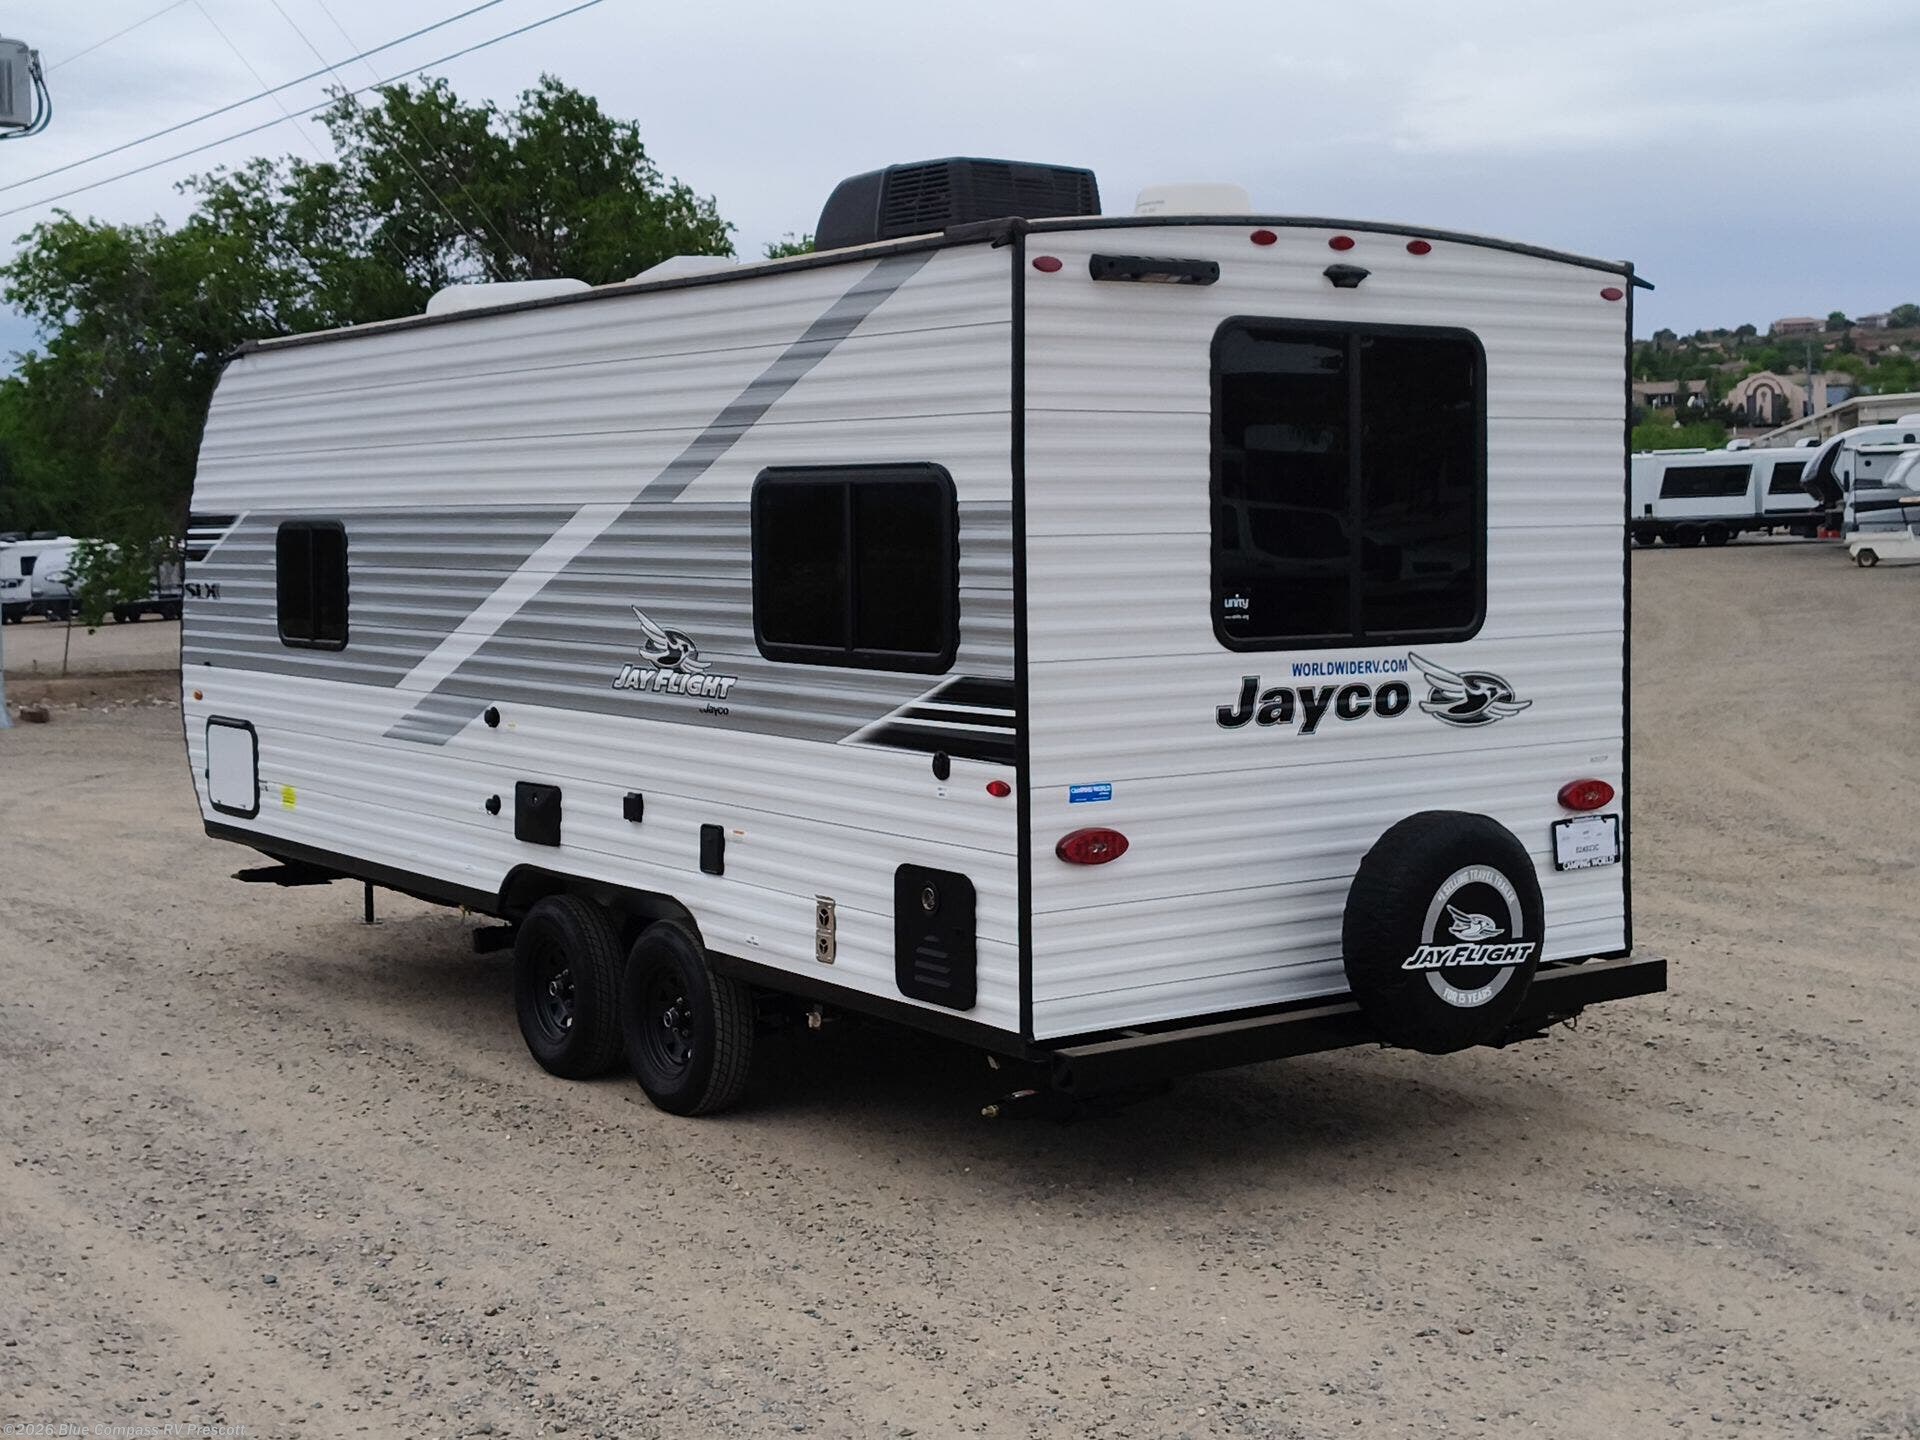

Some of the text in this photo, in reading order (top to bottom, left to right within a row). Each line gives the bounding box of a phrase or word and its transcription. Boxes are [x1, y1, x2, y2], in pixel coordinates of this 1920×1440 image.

[1291, 658, 1408, 677] WORLDWIDERV.COM
[612, 663, 738, 699] JAY FLIGHT
[704, 703, 729, 716] Jayco
[1215, 675, 1412, 735] Jayco
[1401, 942, 1536, 970] JAY FLIGHT
[1467, 986, 1493, 1003] YEARS
